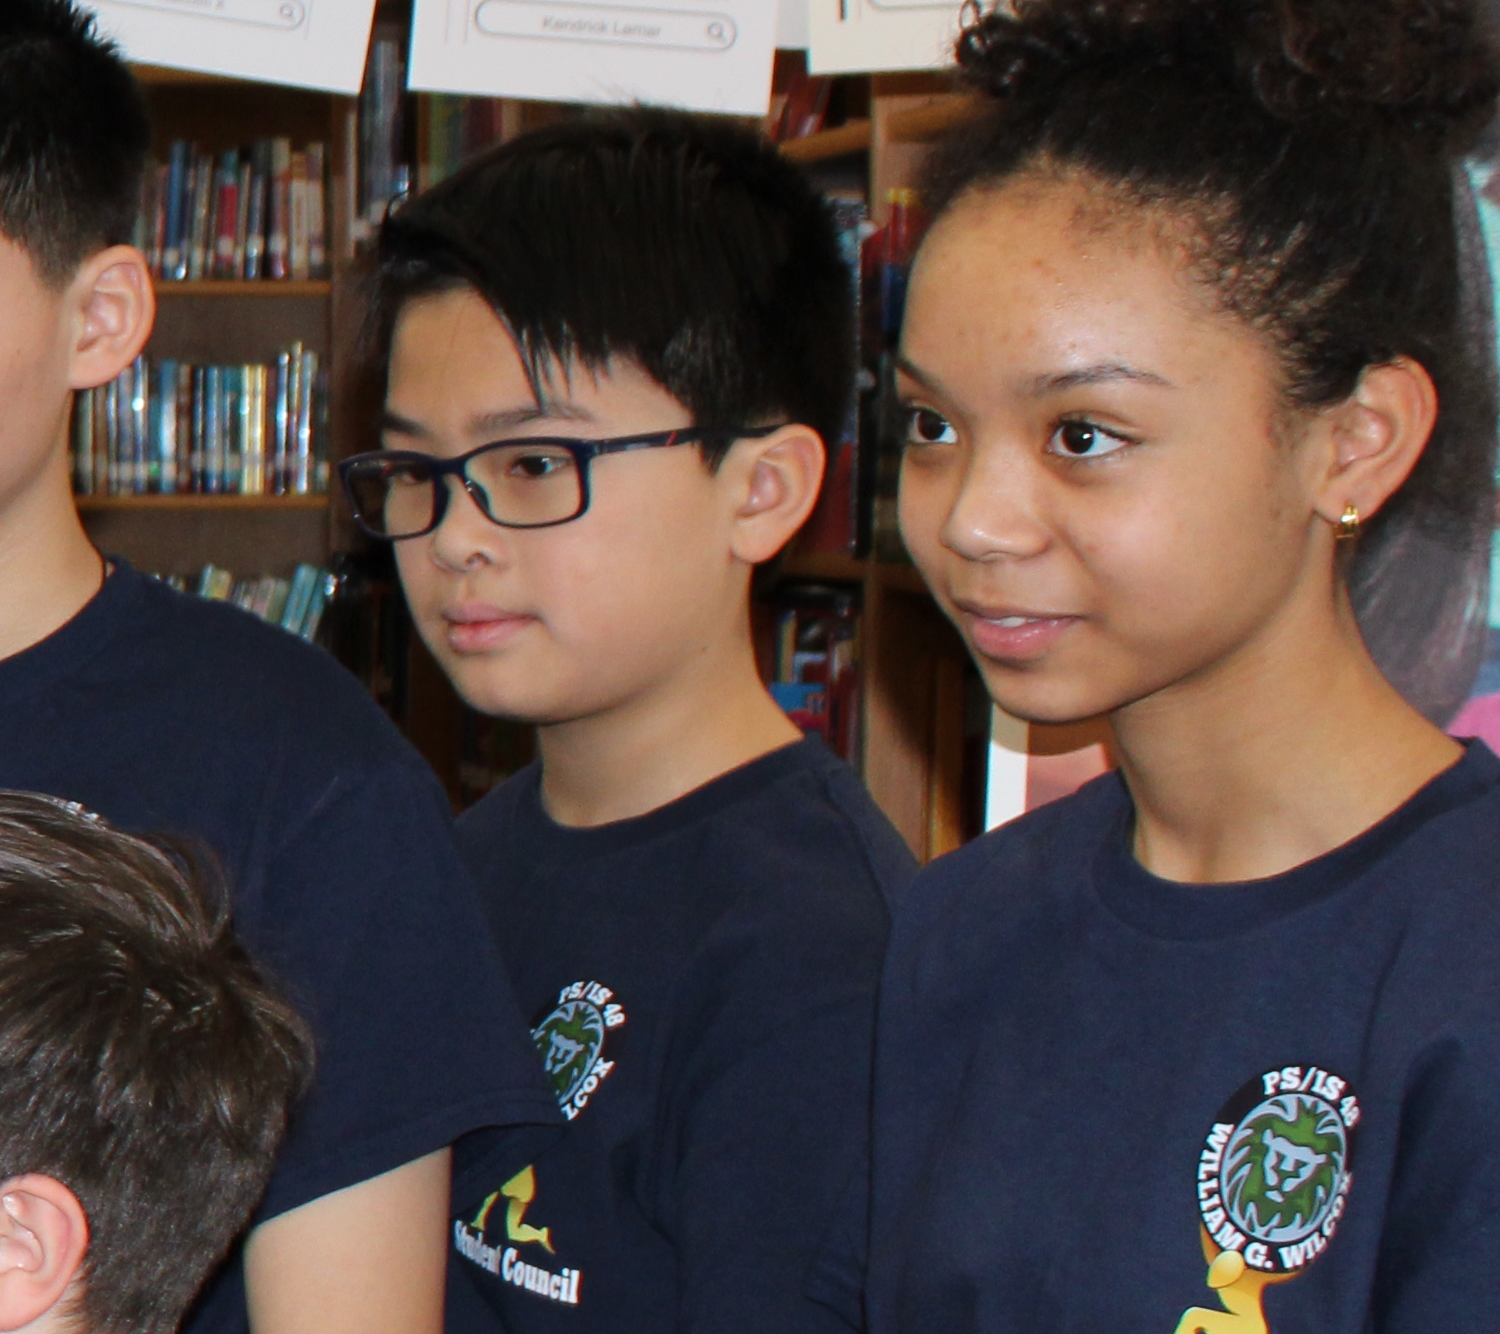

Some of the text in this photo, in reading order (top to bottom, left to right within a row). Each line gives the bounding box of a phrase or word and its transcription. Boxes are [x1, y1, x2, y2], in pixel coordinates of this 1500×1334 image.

[603, 1003, 626, 1026] 48
[561, 1057, 615, 1120] LCOX
[1263, 1066, 1346, 1101] PS/IS
[1198, 1122, 1353, 1268] WILLIAM G. WILCOX
[502, 1247, 581, 1304] Council
